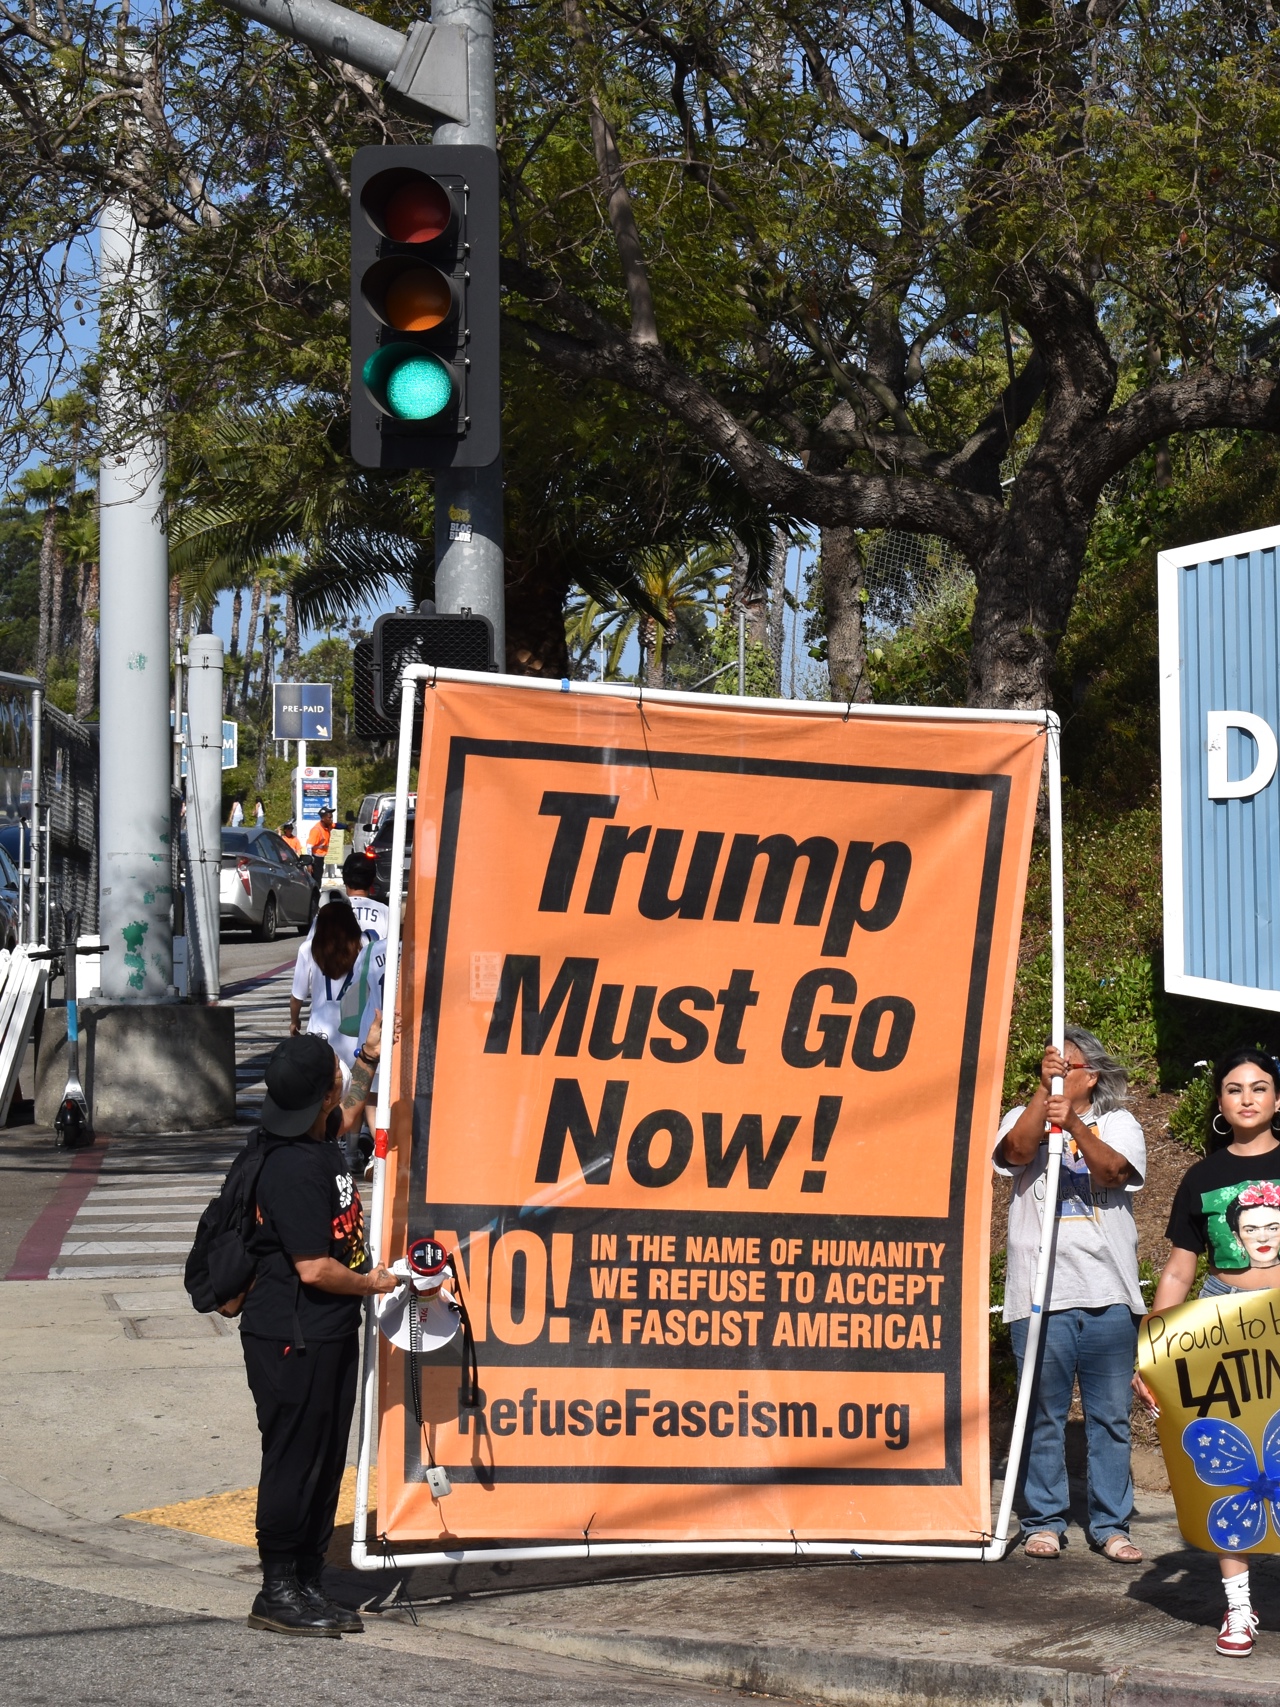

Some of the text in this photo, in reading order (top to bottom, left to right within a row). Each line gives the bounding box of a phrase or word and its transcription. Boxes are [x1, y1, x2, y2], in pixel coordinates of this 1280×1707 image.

[282, 705, 325, 713] PRE-PAID
[537, 790, 912, 957] Trump
[483, 954, 760, 1065] Must
[781, 967, 916, 1073] Go
[534, 1078, 843, 1193] Now!
[591, 1234, 946, 1269] IN THE NAME OF HUMANITY
[434, 1230, 573, 1346] NO!
[589, 1267, 945, 1306] WE REFUSE TO ACCEPT
[587, 1308, 942, 1349] A FASCIST AMERICA!
[1147, 1303, 1230, 1365] Proud
[1236, 1306, 1267, 1341] to
[457, 1387, 910, 1450] RefuseFascism.org
